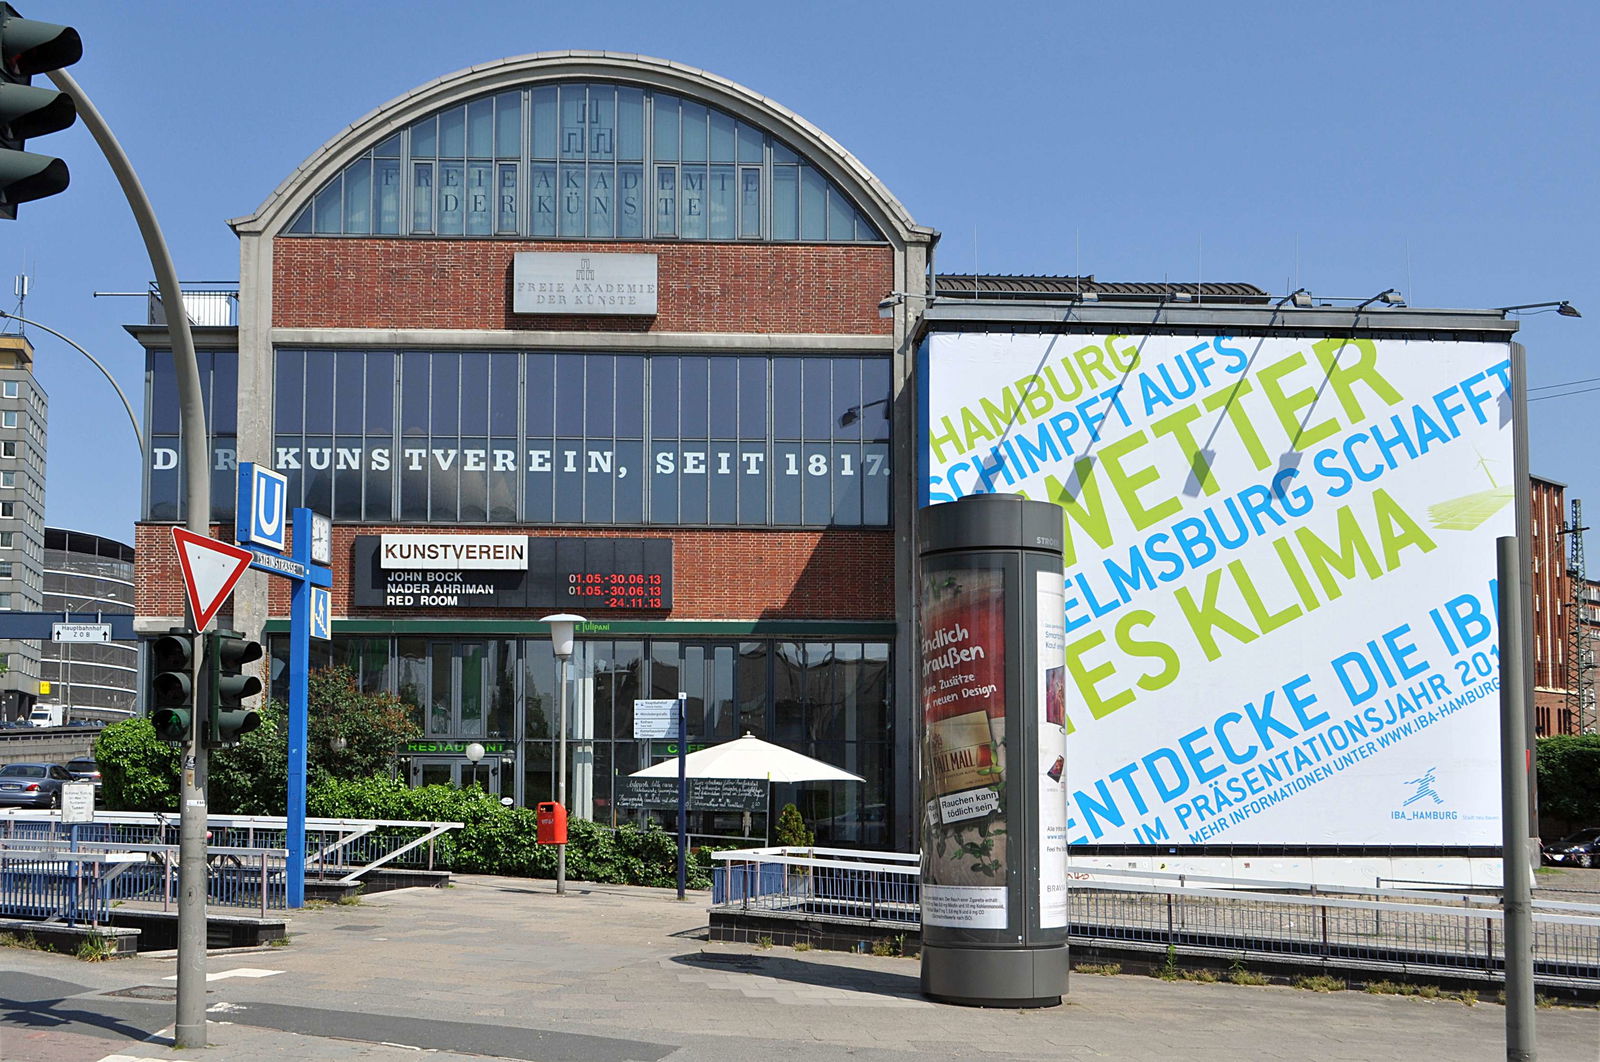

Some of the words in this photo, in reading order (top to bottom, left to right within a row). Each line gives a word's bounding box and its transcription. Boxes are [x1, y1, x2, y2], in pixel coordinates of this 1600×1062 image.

[384, 168, 514, 188] FREIE
[537, 171, 757, 192] AKADEMIE
[443, 194, 516, 213] DER
[537, 192, 701, 216] KÜNSTE
[517, 282, 565, 293] FREIE
[571, 283, 656, 294] AKADEMIE
[536, 295, 567, 305] DER
[574, 293, 637, 305] KÜNSTE
[1138, 336, 1248, 417] AUFS
[930, 334, 1141, 464] HAMBURG
[1313, 359, 1512, 498] SCHAFFT
[1015, 338, 1405, 569] WETTER
[153, 448, 237, 471] DR
[275, 447, 627, 479] KUNSTVEREIN,
[655, 451, 764, 475] SEIT
[784, 453, 891, 477] 1817.
[258, 477, 281, 536] U
[385, 543, 525, 561] KUNSTVEREIN
[387, 571, 423, 582] JOHN
[426, 571, 464, 582] BOCK
[568, 573, 662, 585] 01.05.-30.06.13
[1173, 488, 1437, 662] KLIMA
[387, 583, 430, 594] NADER
[433, 584, 494, 595] AHRIMAN
[568, 585, 662, 597] 01.05.-30.06.13
[386, 595, 414, 606] RED
[420, 595, 458, 606] ROOM
[603, 597, 662, 608] -24.11.13
[1331, 623, 1431, 707] DIE
[1429, 578, 1499, 656] IB
[938, 673, 976, 690] Zusätze
[961, 684, 997, 699] Design
[408, 742, 504, 752] RESTAUNT
[667, 743, 705, 753] CFE
[949, 748, 976, 772] MALL
[1132, 816, 1170, 844] IM
[1173, 674, 1453, 831] PRÄSENTATIONSJAHR
[941, 796, 975, 809] Rauchen
[975, 792, 997, 802] kann
[1188, 817, 1230, 844] MEHR
[1229, 763, 1334, 825] INFORMATIONEN
[1332, 741, 1379, 772] UNTER
[947, 805, 974, 818] tödlich
[975, 803, 993, 811] sein
[1391, 811, 1458, 821] IBA_HAMBURG
